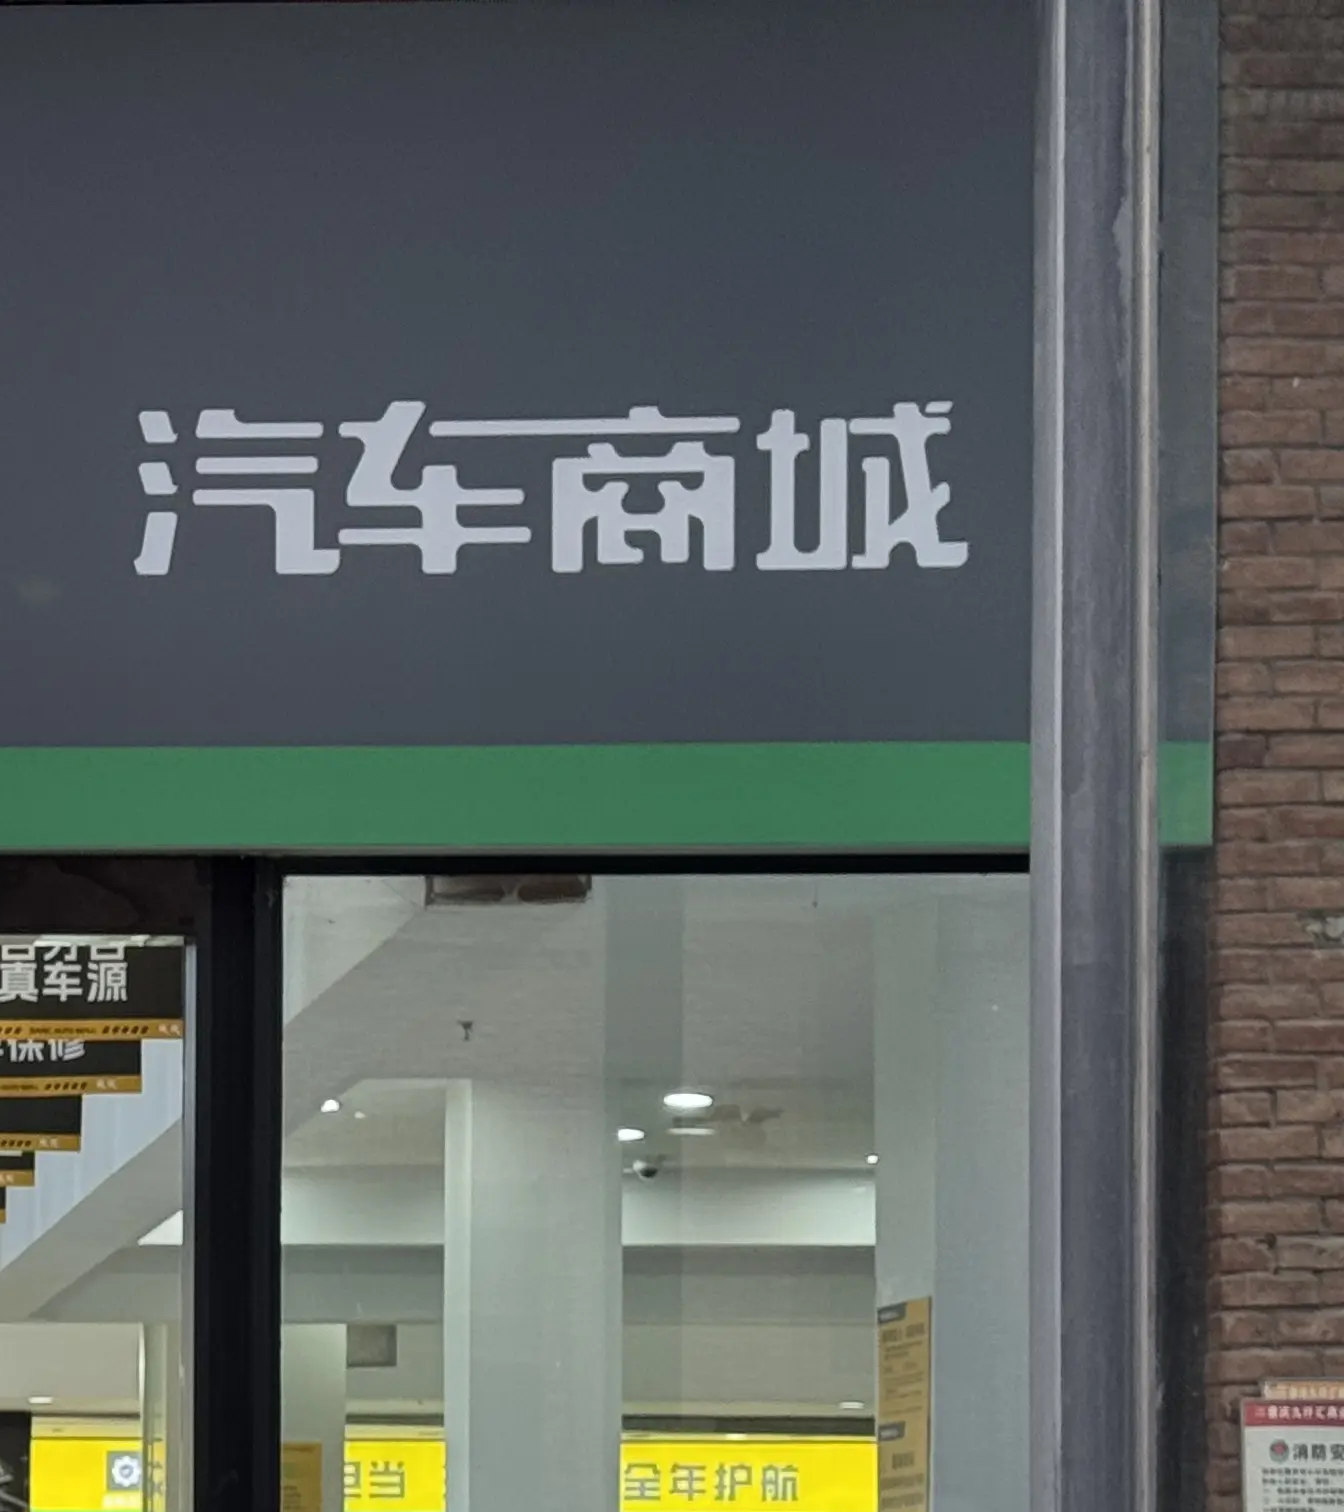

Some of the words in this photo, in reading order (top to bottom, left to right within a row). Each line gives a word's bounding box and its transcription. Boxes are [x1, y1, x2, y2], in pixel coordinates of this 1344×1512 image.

[133, 400, 970, 577] 汽车商城
[623, 1463, 800, 1503] 全年护航
